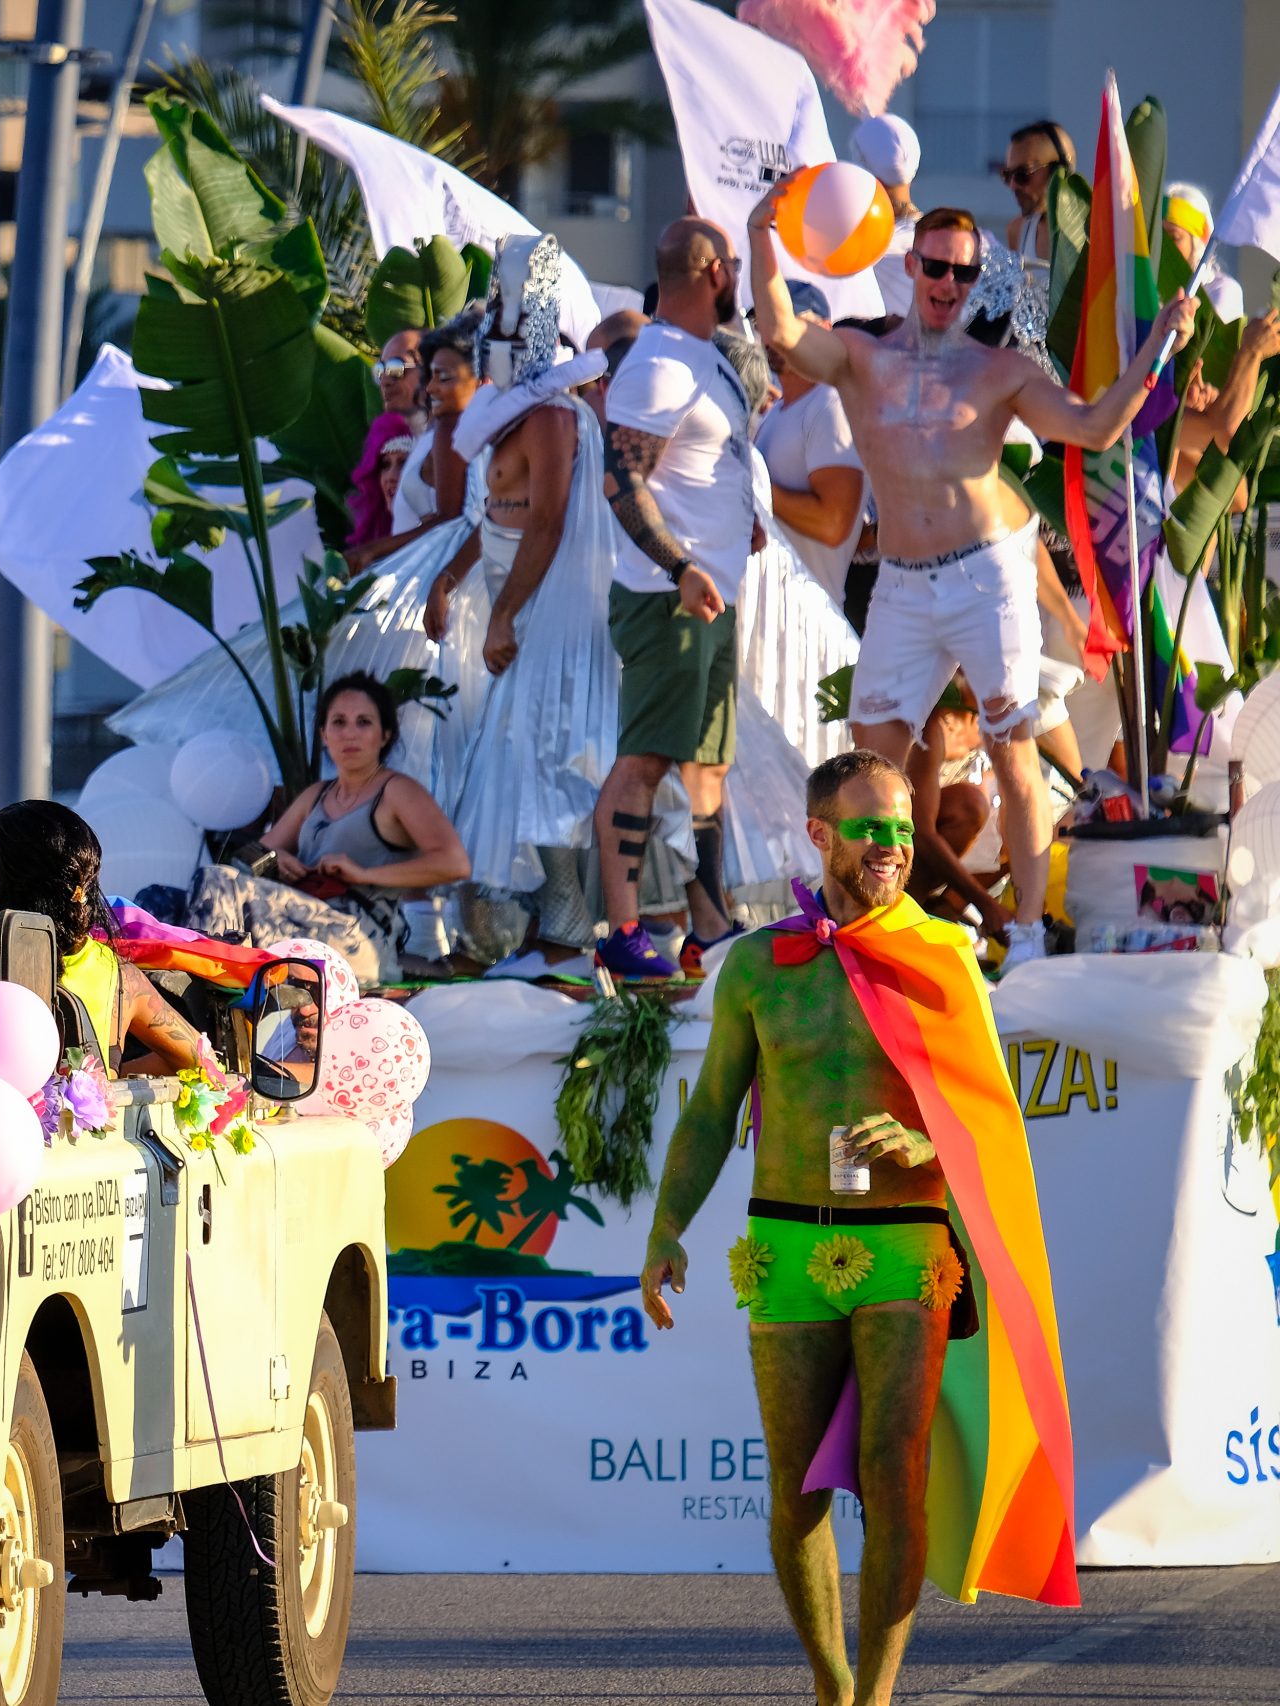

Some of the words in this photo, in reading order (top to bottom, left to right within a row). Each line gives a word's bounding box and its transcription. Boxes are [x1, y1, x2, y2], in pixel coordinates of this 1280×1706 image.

[1008, 1039, 1118, 1118] IZA!
[34, 1188, 61, 1226] Bistro
[64, 1191, 80, 1222] can
[42, 1242, 57, 1282] Tel:
[59, 1240, 76, 1280] 971
[77, 1237, 95, 1277] 808
[97, 1235, 114, 1274] 464
[388, 1283, 649, 1353] a-Bora
[590, 1438, 687, 1481] BALI
